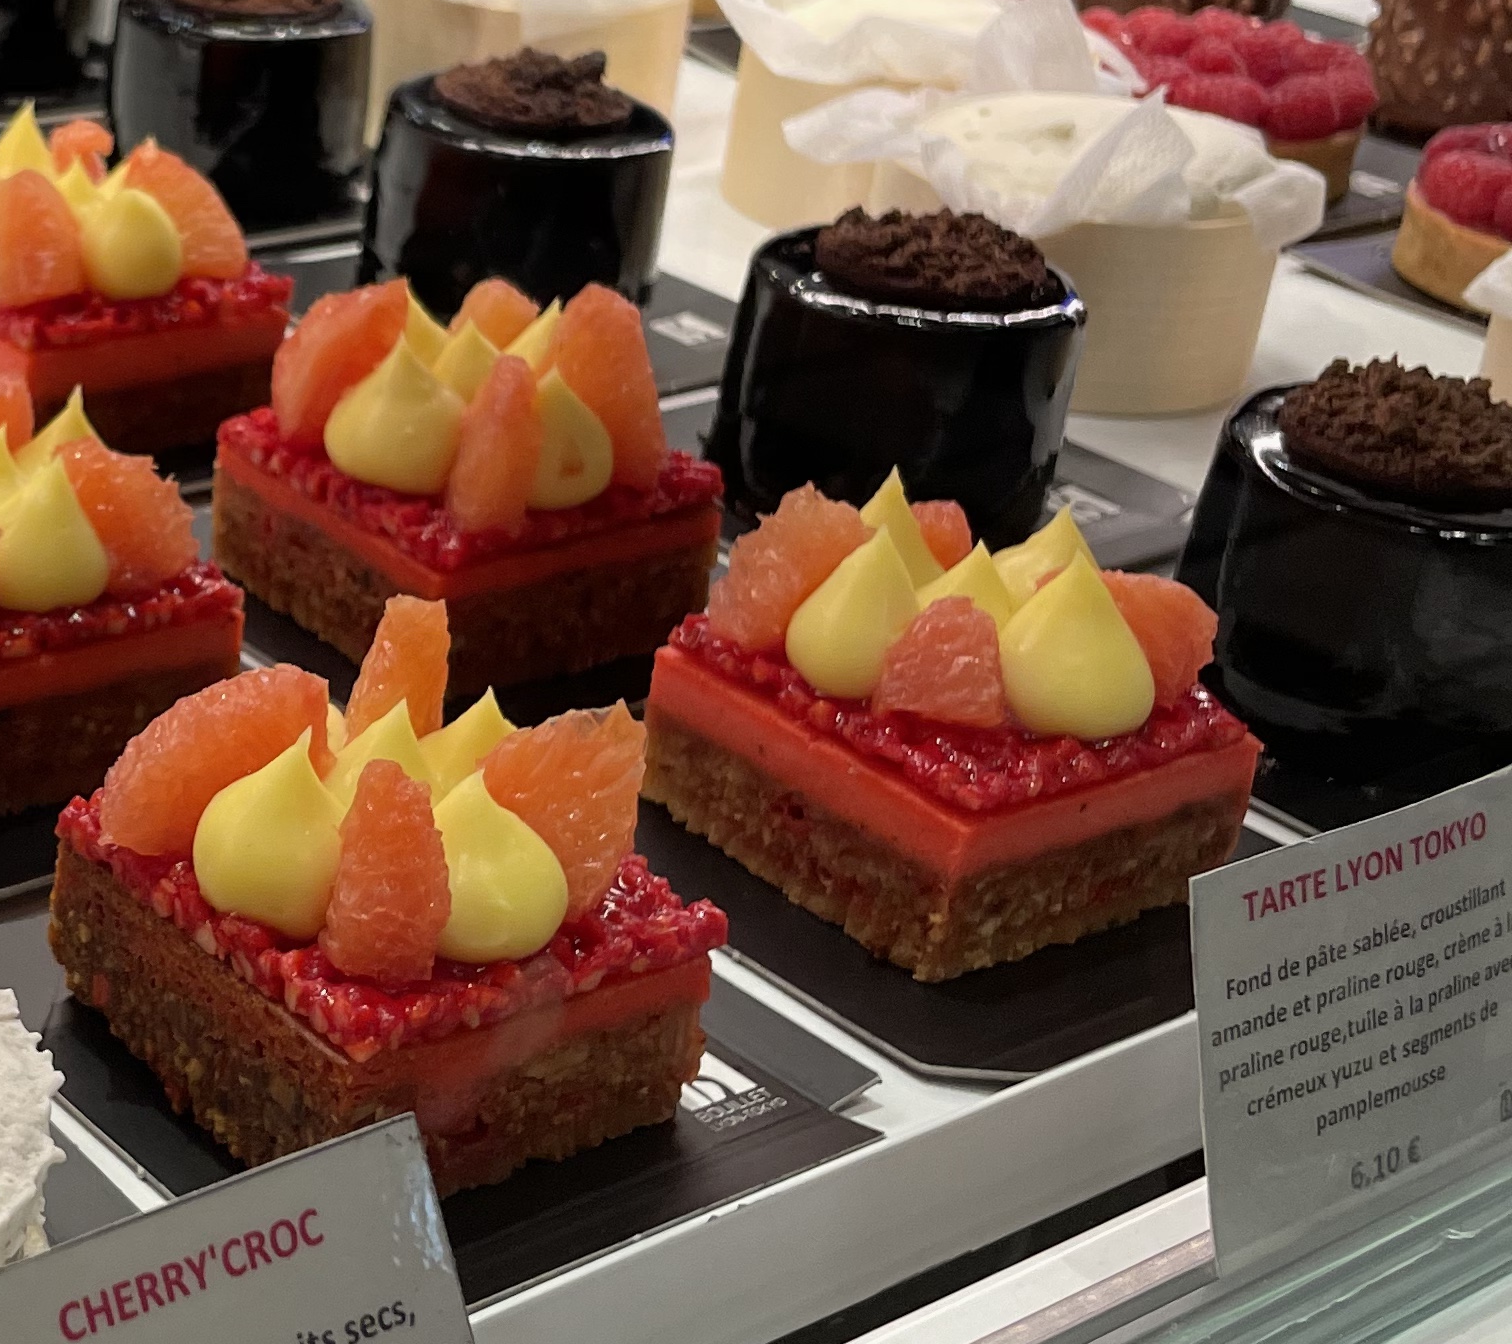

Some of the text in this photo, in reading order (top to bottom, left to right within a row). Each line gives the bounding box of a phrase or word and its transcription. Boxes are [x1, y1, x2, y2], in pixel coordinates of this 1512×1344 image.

[1241, 811, 1487, 921] TARTE LYON TOKYO
[1211, 1004, 1289, 1047] amande
[1293, 995, 1312, 1017] et
[1317, 973, 1383, 1014] praline
[1386, 953, 1439, 984] rouge,
[1443, 928, 1491, 960] crème
[1494, 917, 1503, 938] à
[1227, 878, 1506, 1000] Fond de pâte sablée, croustillant
[1218, 1049, 1284, 1093] praline
[1394, 999, 1404, 1021] à
[1409, 994, 1425, 1016] la
[1428, 971, 1480, 1013] praline
[1484, 955, 1512, 981] ave
[1247, 999, 1498, 1116] crémeux yuzu et segments de
[1317, 1065, 1446, 1136] pamplemousse
[59, 1208, 324, 1342] CHERRY'CROC
